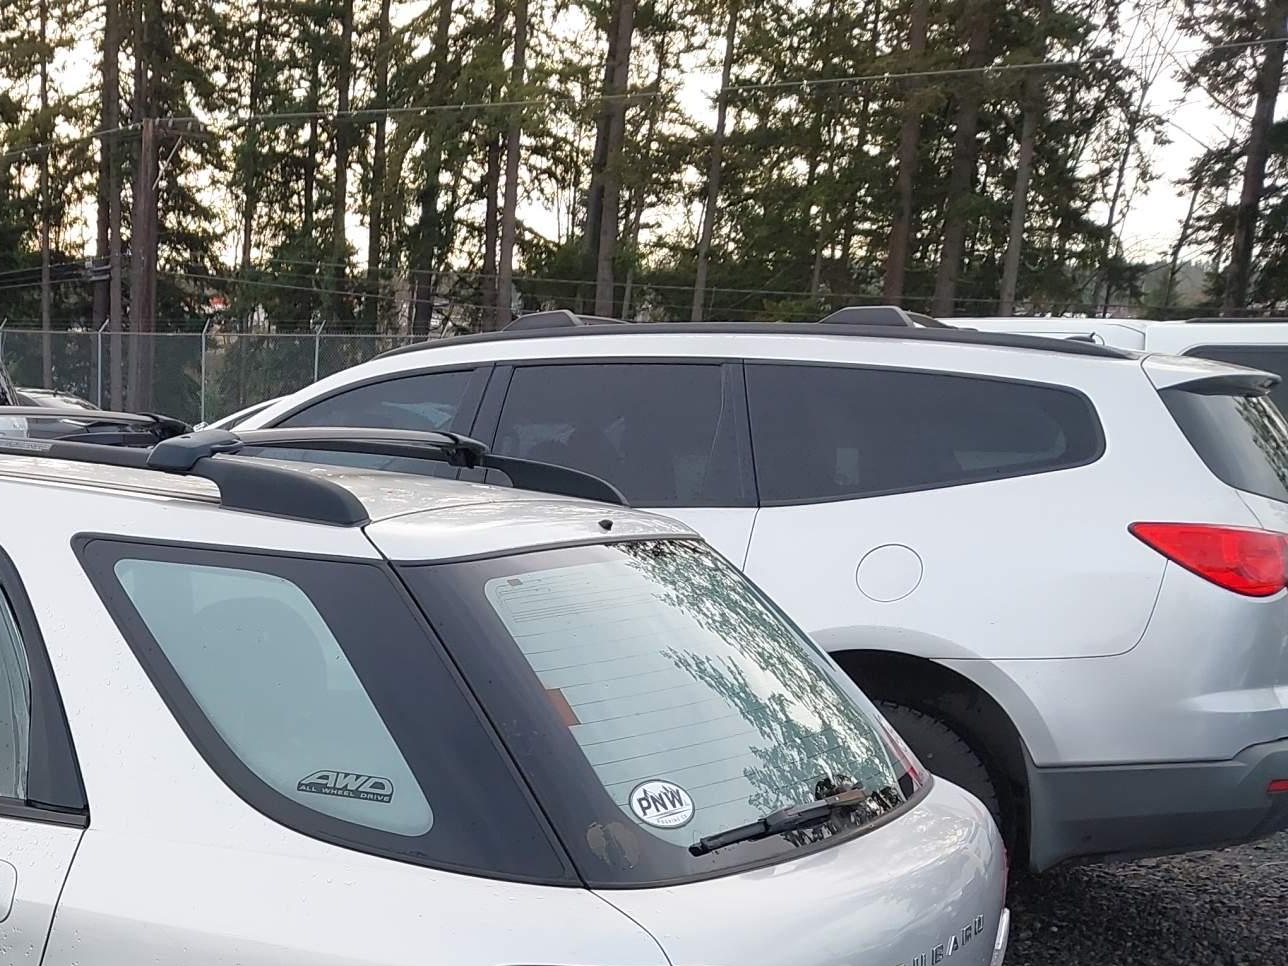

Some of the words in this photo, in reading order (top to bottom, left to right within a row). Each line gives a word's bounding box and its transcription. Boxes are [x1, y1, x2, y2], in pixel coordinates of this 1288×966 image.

[298, 784, 317, 793] ALL
[322, 788, 355, 798] WHEEL
[360, 792, 390, 802] DRIVE
[300, 771, 393, 796] AWD
[636, 785, 684, 817] PNW
